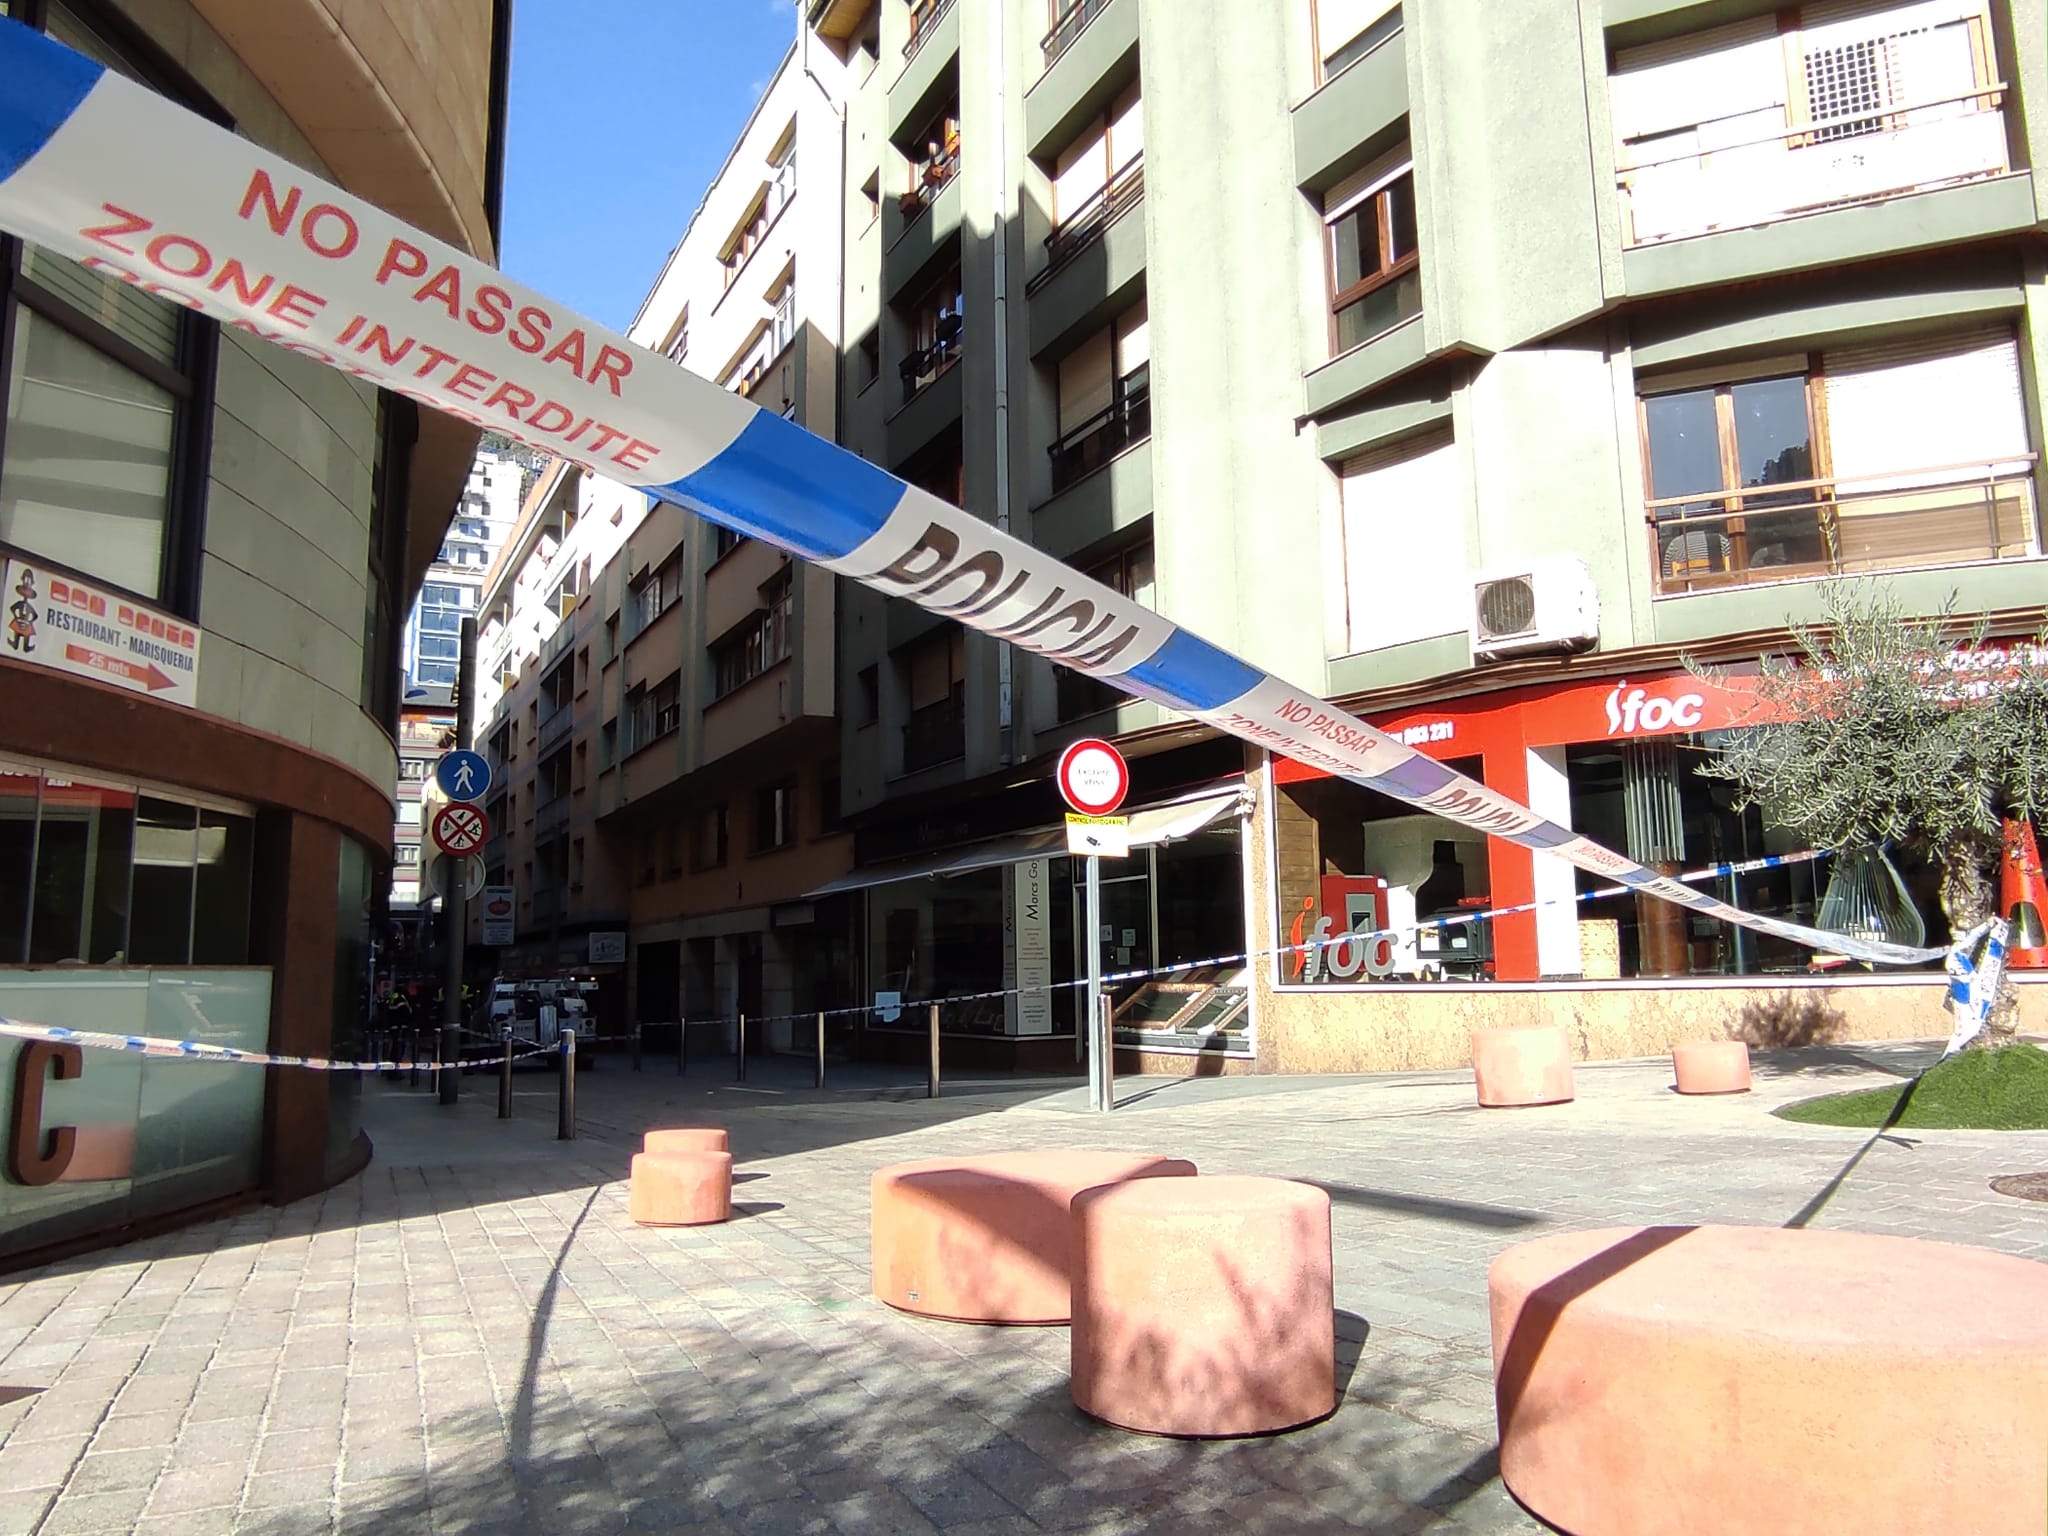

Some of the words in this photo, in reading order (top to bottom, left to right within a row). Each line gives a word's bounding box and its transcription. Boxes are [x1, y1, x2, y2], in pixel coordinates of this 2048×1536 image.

[238, 168, 359, 259] NO
[375, 237, 634, 398] PASSAR
[80, 202, 327, 329] ZONE
[335, 315, 661, 471] INTERDITE
[47, 608, 121, 647] RESTAURANT
[129, 636, 194, 672] MARISQUERIA
[87, 653, 105, 668] 25
[107, 659, 130, 676] mts
[1275, 699, 1312, 723] NO
[1305, 714, 1377, 754] PASSAR
[1029, 859, 1039, 878] Go
[1026, 882, 1039, 920] Marcs
